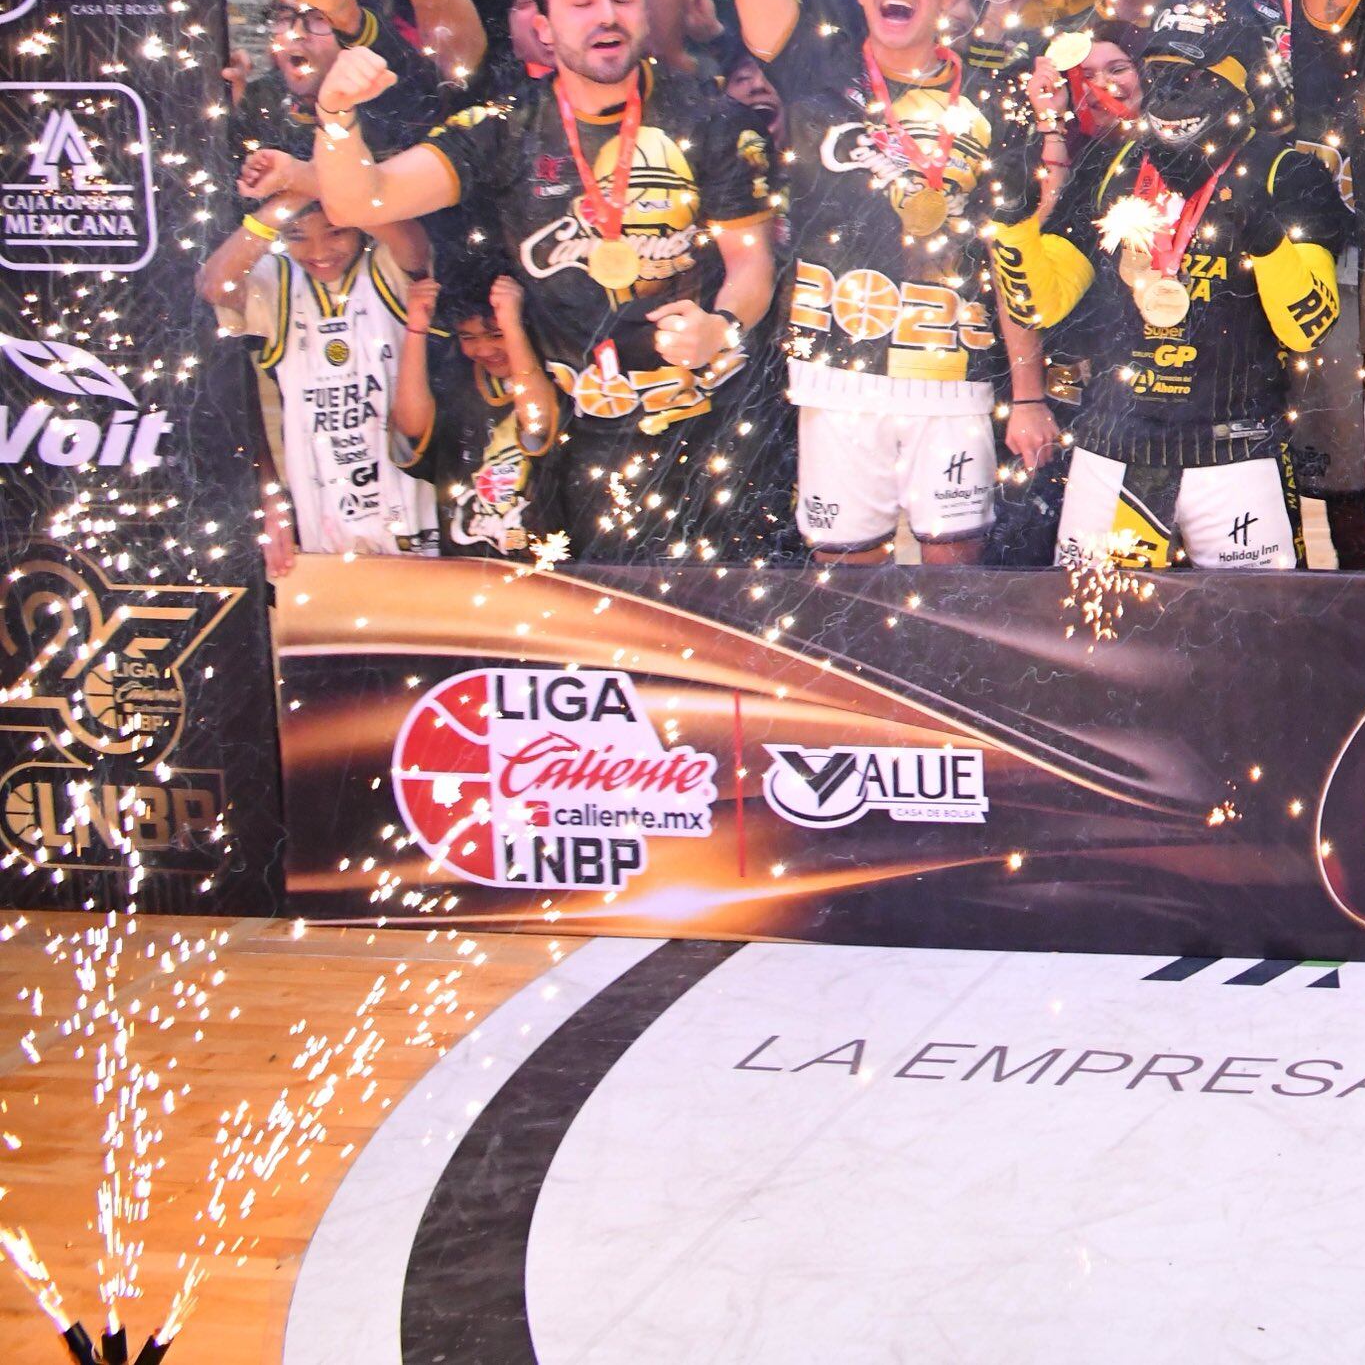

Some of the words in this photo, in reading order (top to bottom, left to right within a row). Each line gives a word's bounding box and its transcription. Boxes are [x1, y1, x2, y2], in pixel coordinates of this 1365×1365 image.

[4, 213, 137, 236] MEXICANA
[1154, 344, 1198, 368] GP
[1219, 548, 1261, 563] Holiday
[1261, 543, 1280, 556] Inn
[496, 677, 638, 723] LIGA
[499, 731, 710, 797] Caliente
[769, 750, 979, 822] VALUE
[553, 803, 705, 832] caliente.mx
[501, 837, 642, 886] LNBP
[732, 1035, 868, 1076] LA
